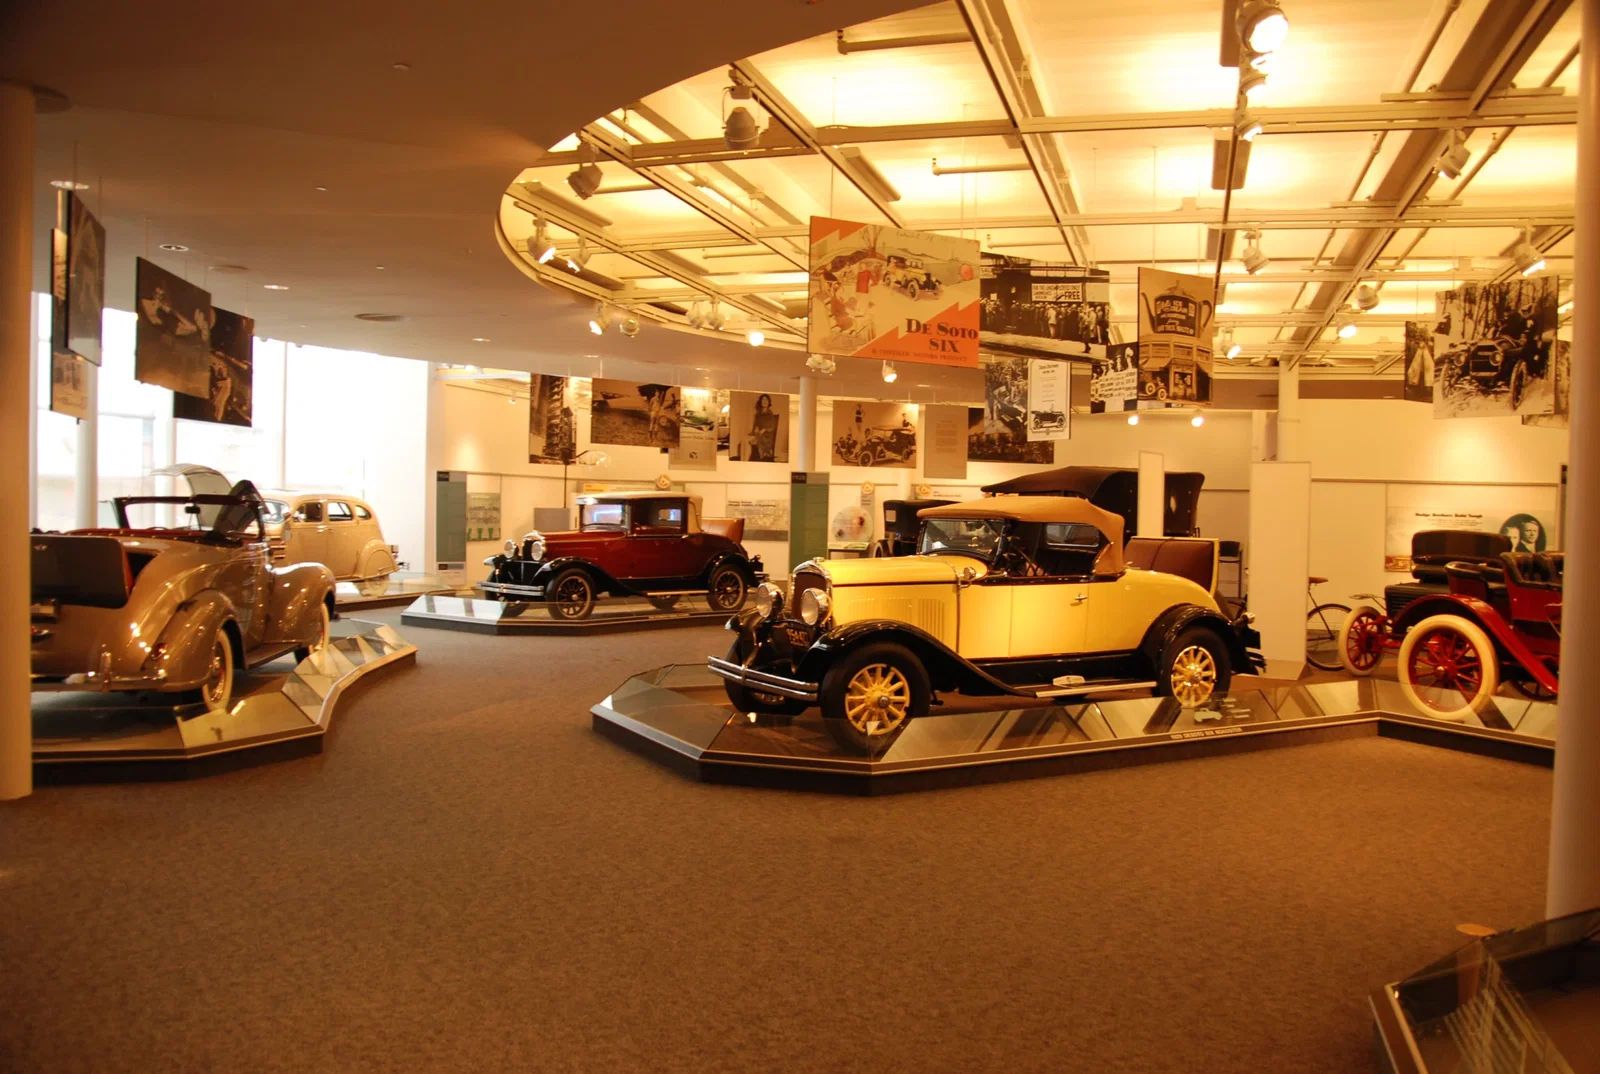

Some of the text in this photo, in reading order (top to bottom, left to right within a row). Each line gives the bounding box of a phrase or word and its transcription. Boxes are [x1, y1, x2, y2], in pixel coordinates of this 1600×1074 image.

[1064, 291, 1080, 300] FREE
[905, 318, 978, 339] DE SOTO
[929, 338, 960, 353] SIX
